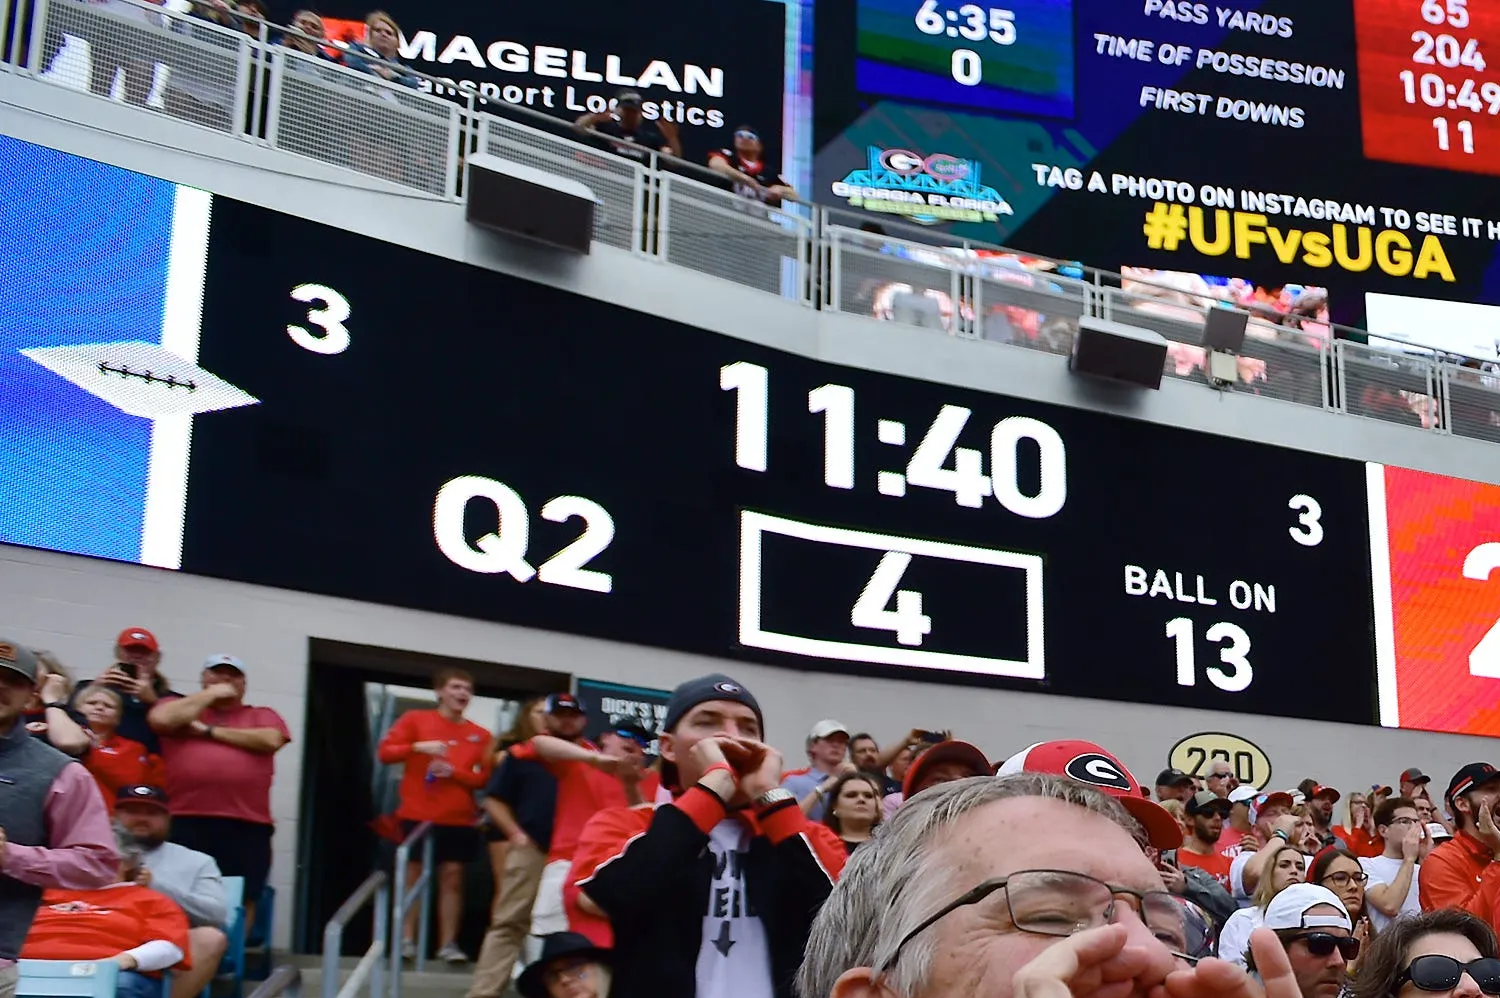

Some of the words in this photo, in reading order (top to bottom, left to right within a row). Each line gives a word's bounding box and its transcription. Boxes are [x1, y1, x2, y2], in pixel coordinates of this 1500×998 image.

[916, 0, 1015, 45] 6:35
[1145, 0, 1209, 25] PASS
[1215, 7, 1294, 38] YARDS
[1421, 0, 1469, 29] 65
[397, 30, 725, 98] MAGELLAN
[952, 49, 982, 86] 0
[1094, 33, 1155, 62] TIME
[1158, 44, 1193, 66] OF
[1196, 48, 1345, 90] POSSESSION
[1411, 31, 1487, 72] 204
[416, 77, 555, 108] ansport
[1139, 86, 1213, 116] FIRST
[1216, 97, 1307, 129] DOWNS
[1432, 116, 1475, 154] 11
[1032, 163, 1083, 191] TAG
[1087, 171, 1107, 194] A
[1111, 173, 1196, 203] PHOTO
[1200, 184, 1235, 213] ON
[1241, 190, 1376, 228] INSTAGRAM
[1380, 207, 1410, 230] TO
[1415, 211, 1458, 237] SEE
[1462, 218, 1484, 239] IT
[1143, 202, 1457, 283] #UFvsUGA
[287, 283, 351, 355] 3
[720, 361, 1068, 519] 11:40
[433, 475, 615, 593] Q2
[1288, 494, 1324, 546] 3
[851, 551, 931, 645] 4
[1124, 565, 1218, 606] BALL
[1229, 579, 1276, 613] ON
[1165, 617, 1254, 692] 13
